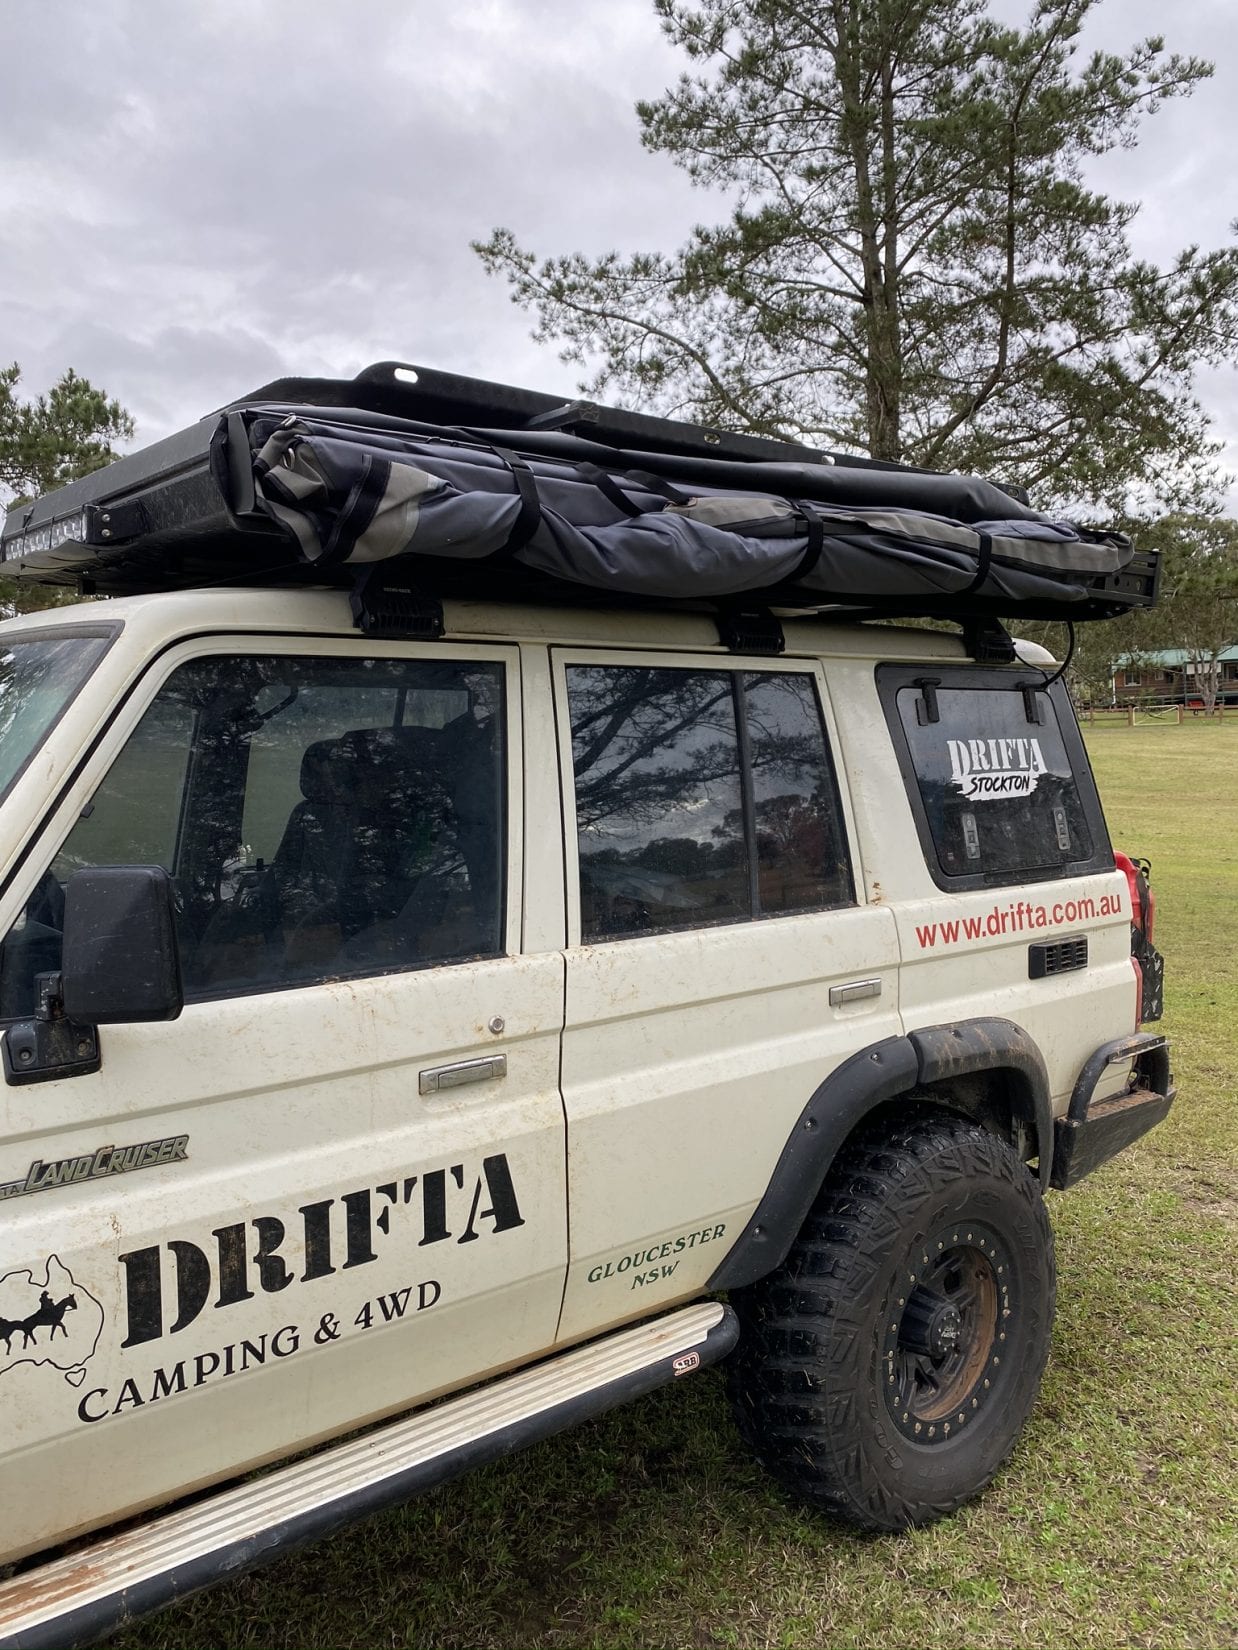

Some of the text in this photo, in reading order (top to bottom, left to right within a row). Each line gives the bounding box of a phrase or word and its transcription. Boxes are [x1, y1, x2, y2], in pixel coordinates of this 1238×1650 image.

[947, 738, 1049, 776] DRIFTA
[970, 775, 1031, 795] STOCKTON
[915, 894, 1122, 948] www.drifta.com.au
[118, 1152, 526, 1350] DRIFTA
[587, 1223, 726, 1284] GLOUCESTER
[631, 1260, 681, 1290] NSW
[77, 1280, 443, 1424] CAMPING & 4WD
